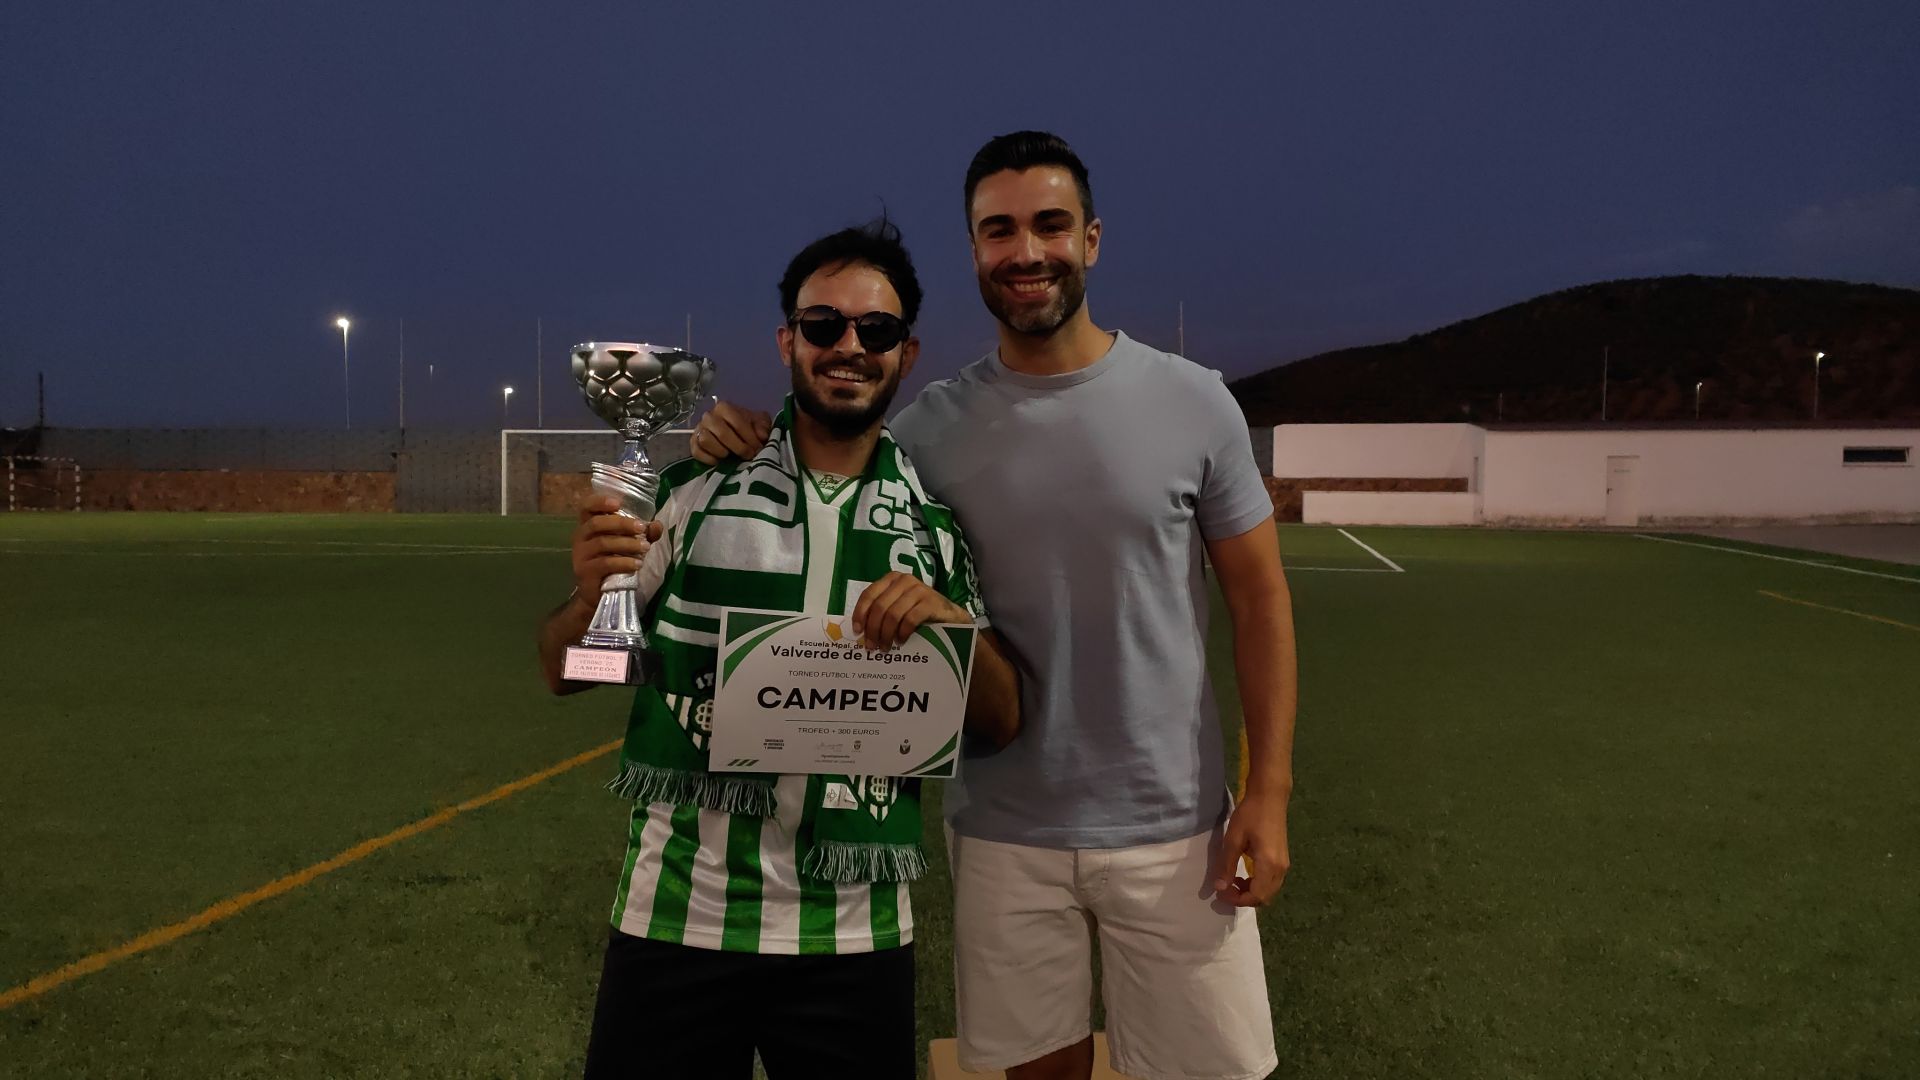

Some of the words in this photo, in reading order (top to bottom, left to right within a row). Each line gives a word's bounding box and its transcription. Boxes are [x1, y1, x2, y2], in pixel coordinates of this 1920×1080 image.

[770, 645, 839, 659] Valverde
[843, 649, 862, 660] de
[866, 651, 929, 664] Leganés
[858, 672, 888, 680] VERANO
[757, 685, 930, 713] CAMPEÓN
